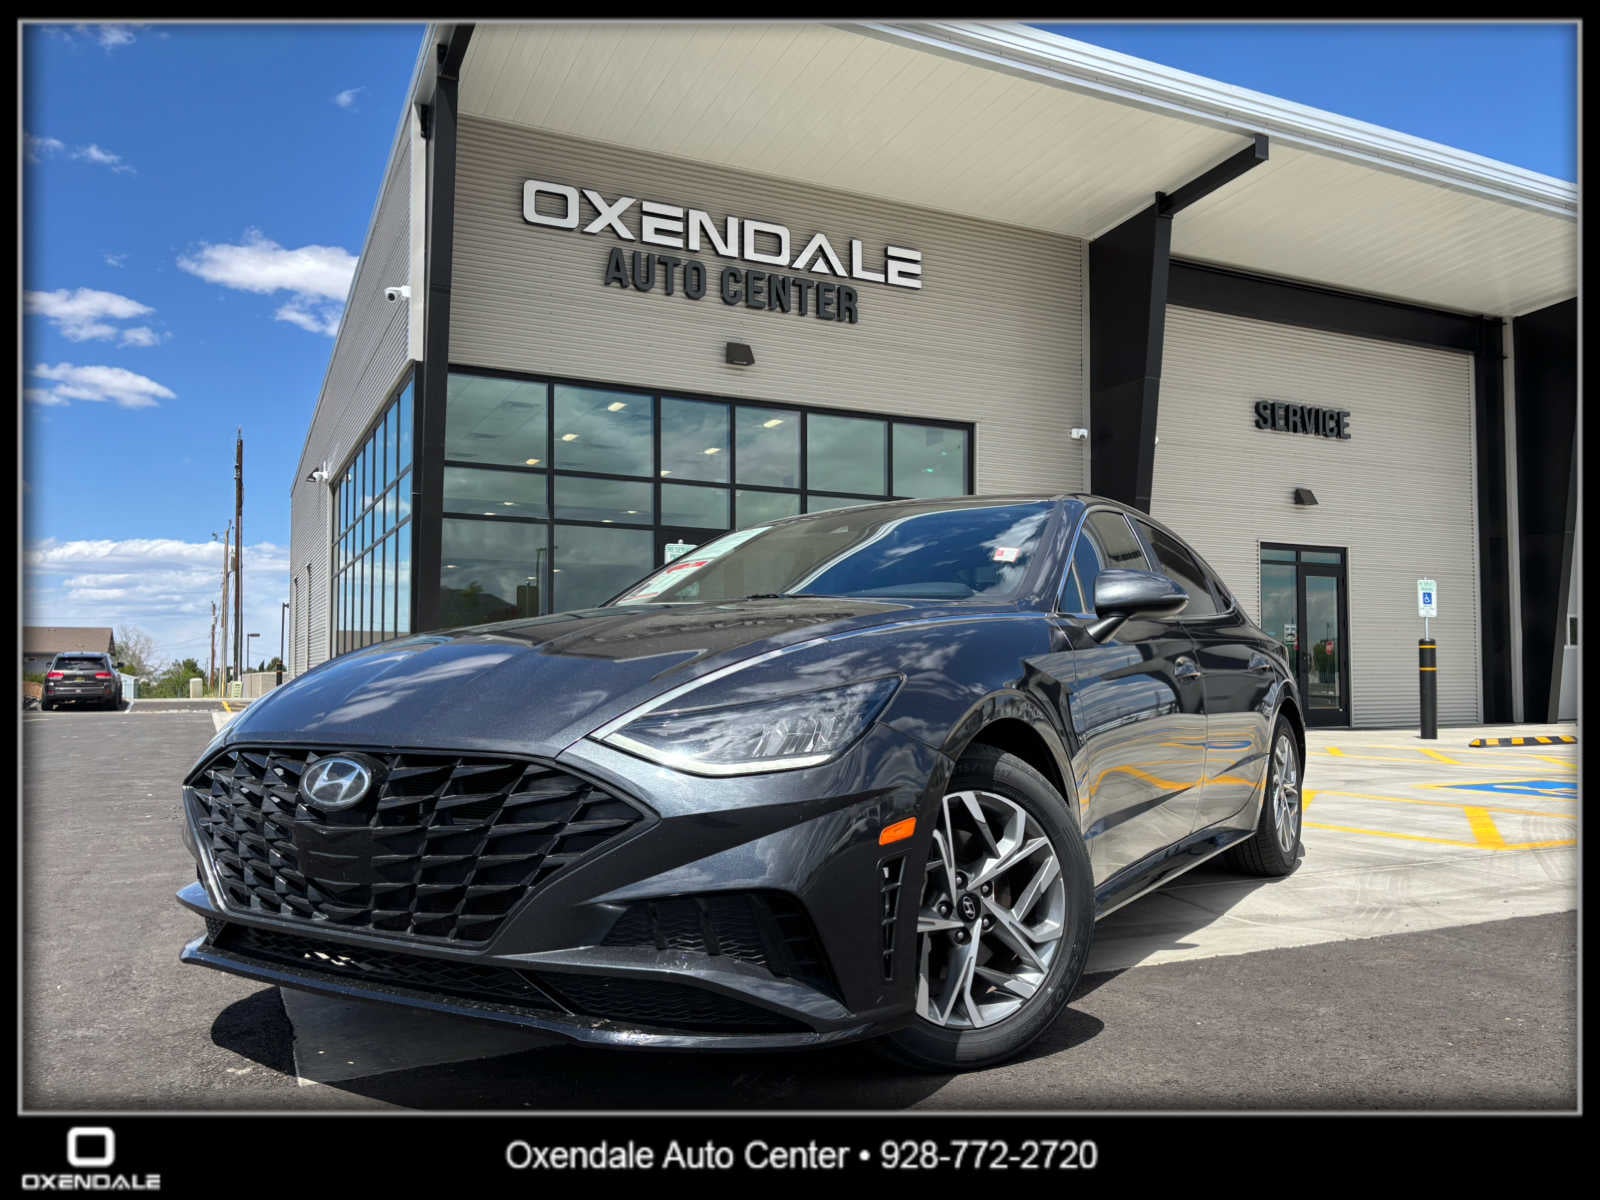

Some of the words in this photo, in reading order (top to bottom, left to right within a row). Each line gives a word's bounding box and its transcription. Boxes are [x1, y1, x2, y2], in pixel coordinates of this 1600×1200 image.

[522, 179, 922, 289] OXENDALE
[604, 246, 707, 301] AUTO
[720, 265, 859, 325] CENTER
[1254, 400, 1351, 439] SERVICE
